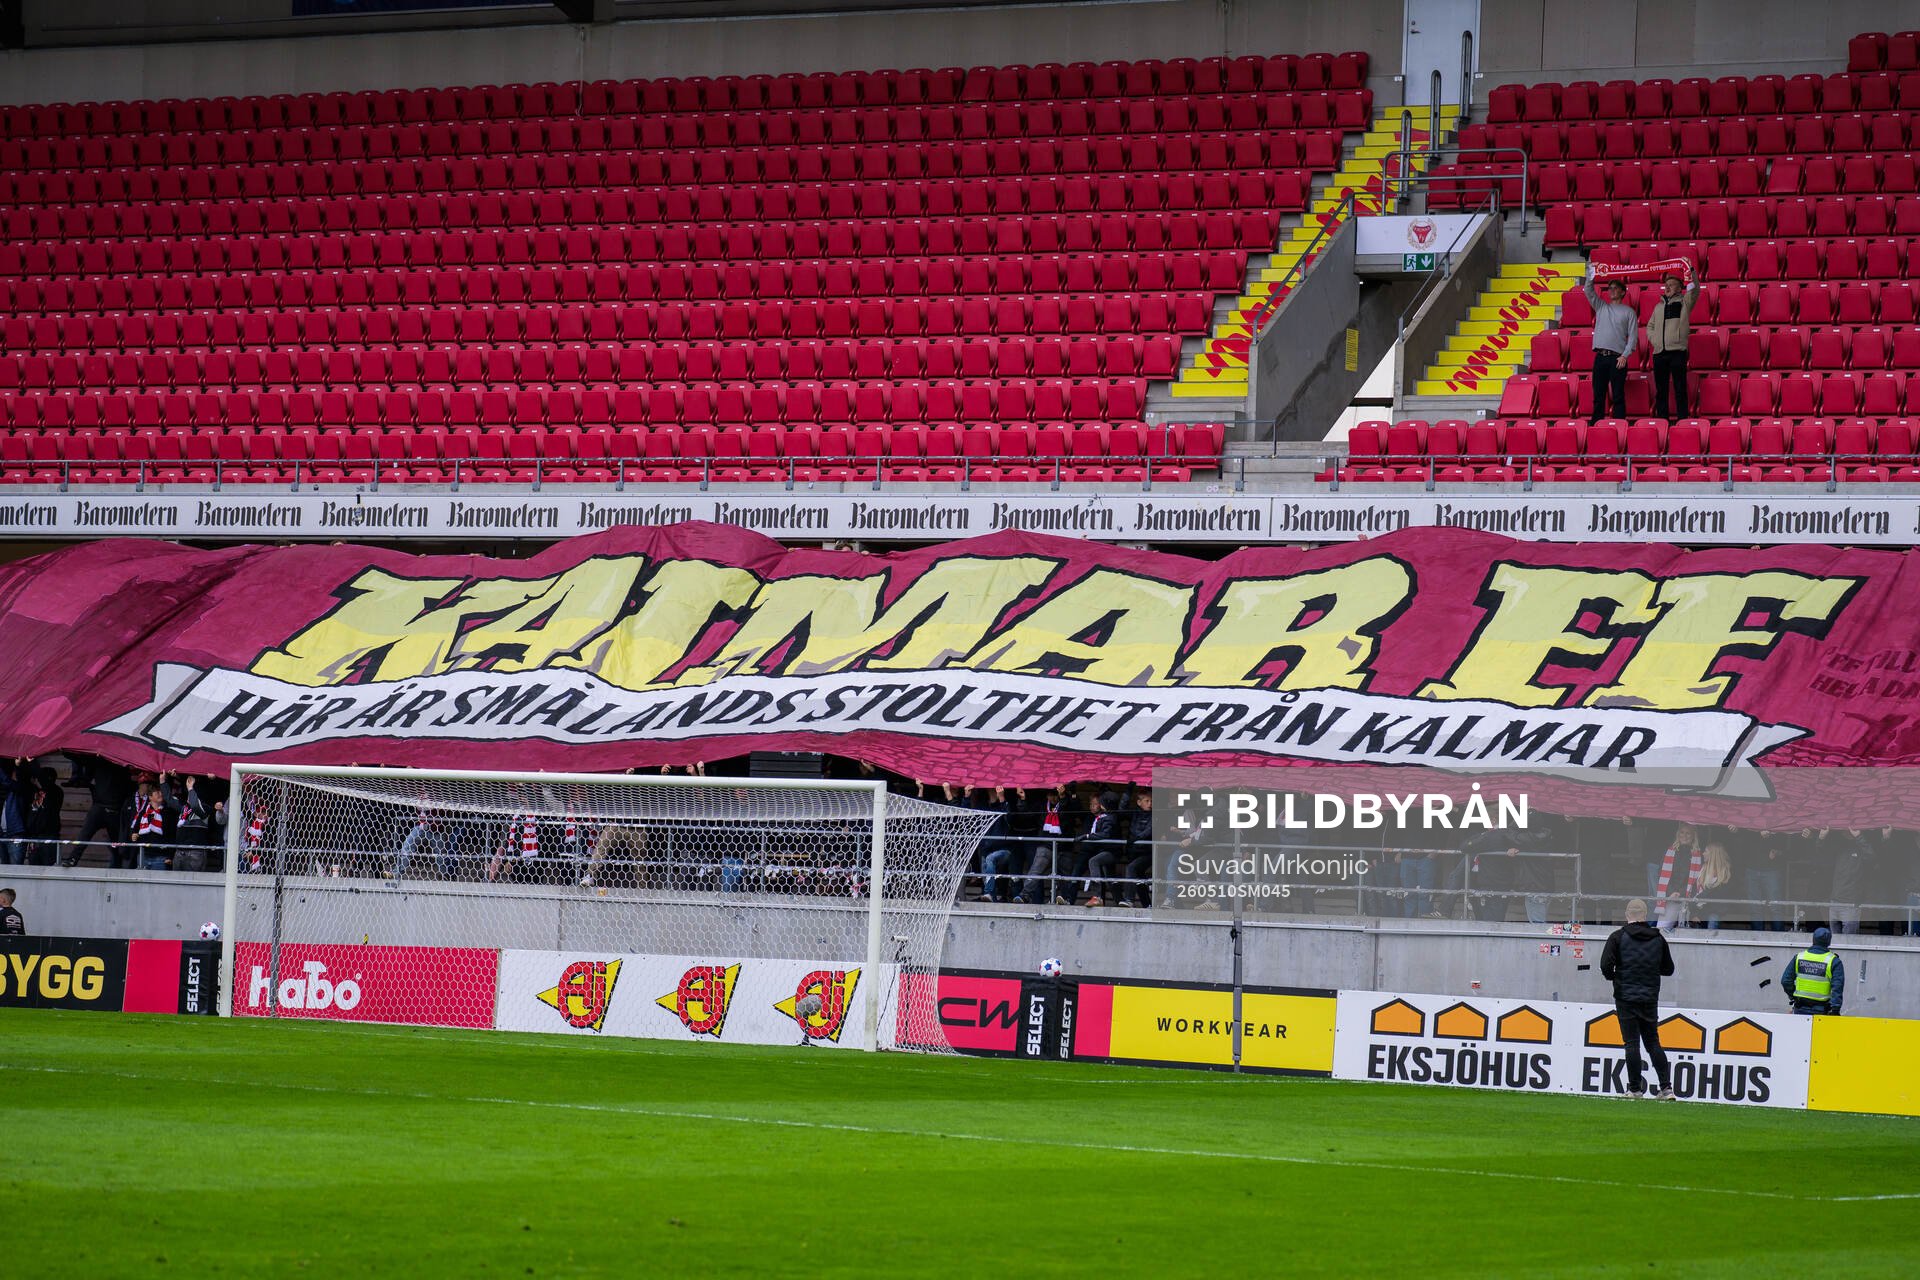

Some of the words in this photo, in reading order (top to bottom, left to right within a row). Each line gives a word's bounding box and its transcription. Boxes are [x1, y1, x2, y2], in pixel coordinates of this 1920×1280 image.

[73, 501, 177, 525] Barometern
[194, 501, 301, 526] Barometern
[318, 501, 428, 527] Barometern
[446, 502, 558, 528] Barometern
[577, 502, 692, 528] Barometern
[714, 502, 829, 529] Barometern
[848, 502, 969, 530] Barometern
[989, 502, 1113, 531] Barometern
[1133, 503, 1261, 532] Barometern
[1280, 503, 1410, 532] Barometern
[1434, 504, 1566, 533] Barometern
[1588, 504, 1726, 534] Barometern
[1749, 505, 1889, 535] Barometern
[1412, 560, 1869, 710] FF
[201, 689, 357, 739] HÄR
[335, 683, 447, 729] ÄR
[427, 681, 803, 735] SMÅLANDS
[797, 682, 1158, 742] STOLTHET
[1153, 692, 1348, 746] FRÅN
[1340, 714, 1658, 773] KALMAR
[0, 953, 105, 1000] YGG
[186, 957, 200, 1013] SELECT
[248, 961, 361, 1010] habo
[1027, 995, 1045, 1055] SELECT
[1060, 998, 1073, 1059] SELECT
[1367, 1042, 1552, 1089] EKSJÖHUS
